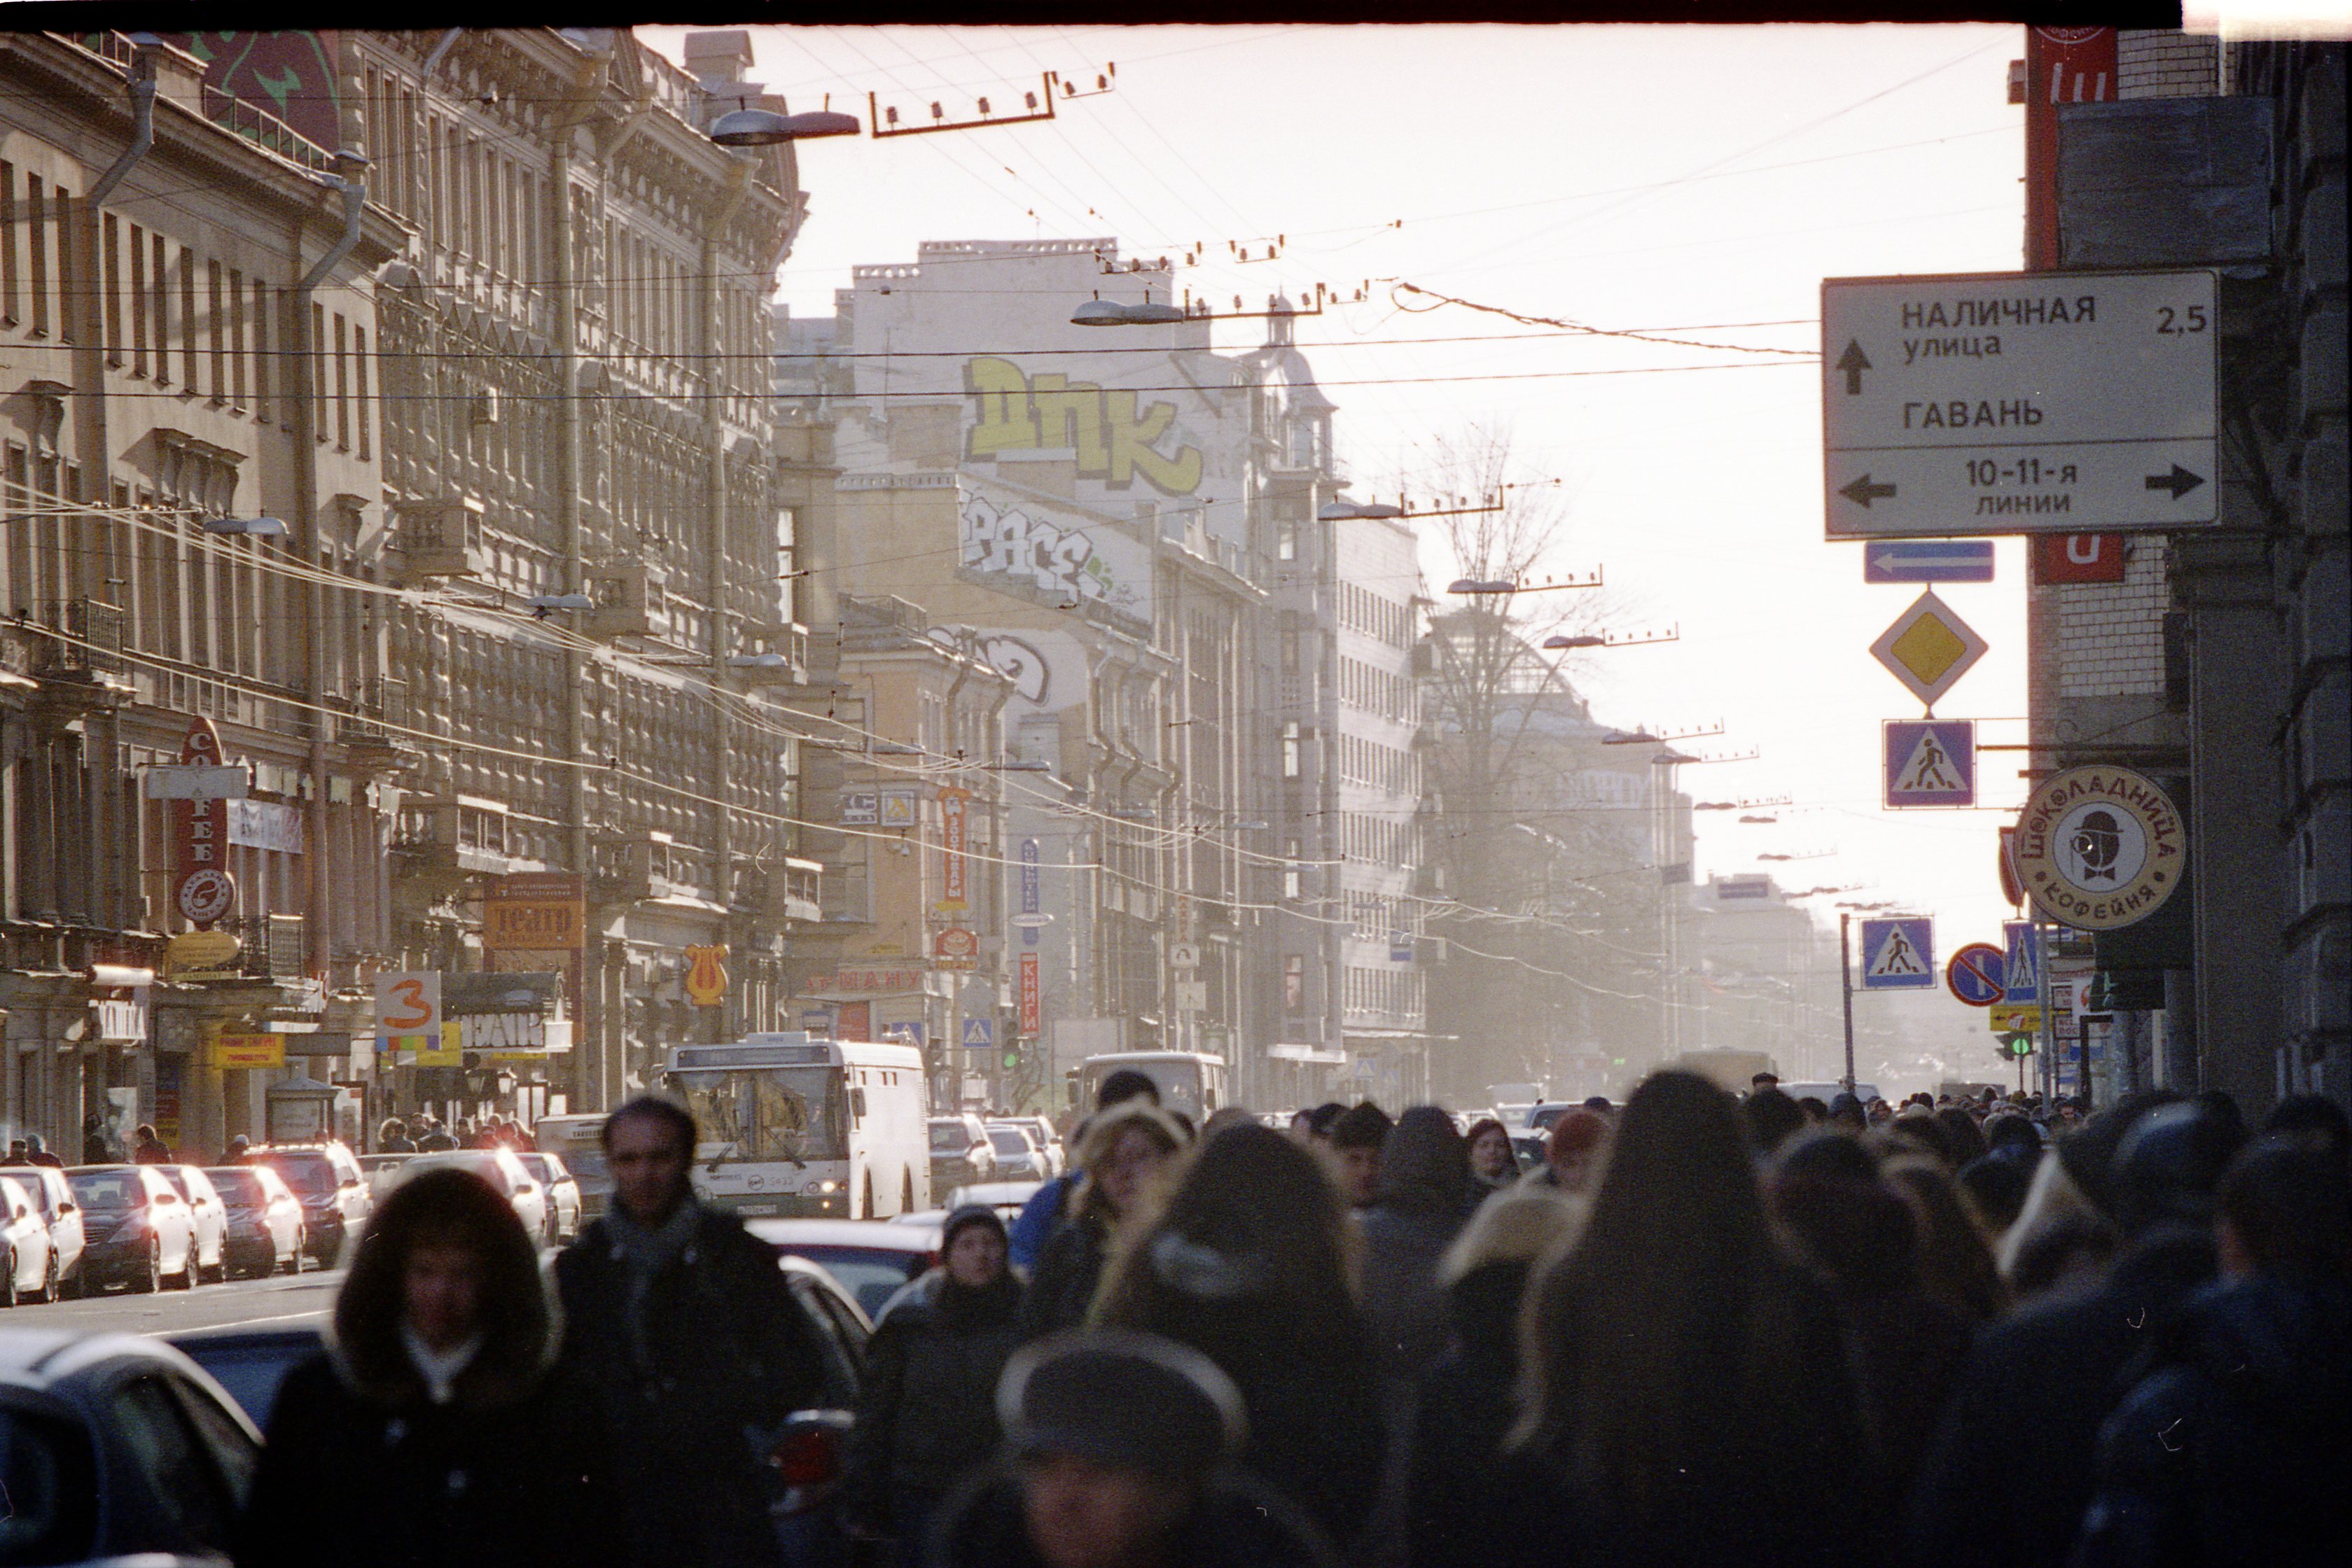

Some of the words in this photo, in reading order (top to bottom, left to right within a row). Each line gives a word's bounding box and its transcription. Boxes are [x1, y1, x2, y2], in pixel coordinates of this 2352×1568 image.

[1902, 297, 2096, 328] НАЛИЧНАЯ
[2157, 306, 2207, 337] 2,5
[1903, 335, 2002, 365] улица
[1902, 400, 2043, 430] ГАВАНЬ
[1965, 459, 2078, 487] 10-11-я
[1975, 493, 2071, 516] линии
[2022, 776, 2176, 860] ШОКОЛАДНИЦА
[948, 816, 961, 897] ЗООТОВАРЫ
[2043, 881, 2157, 919] КОФЕЙНЯ
[1024, 963, 1036, 1029] КНИГИ
